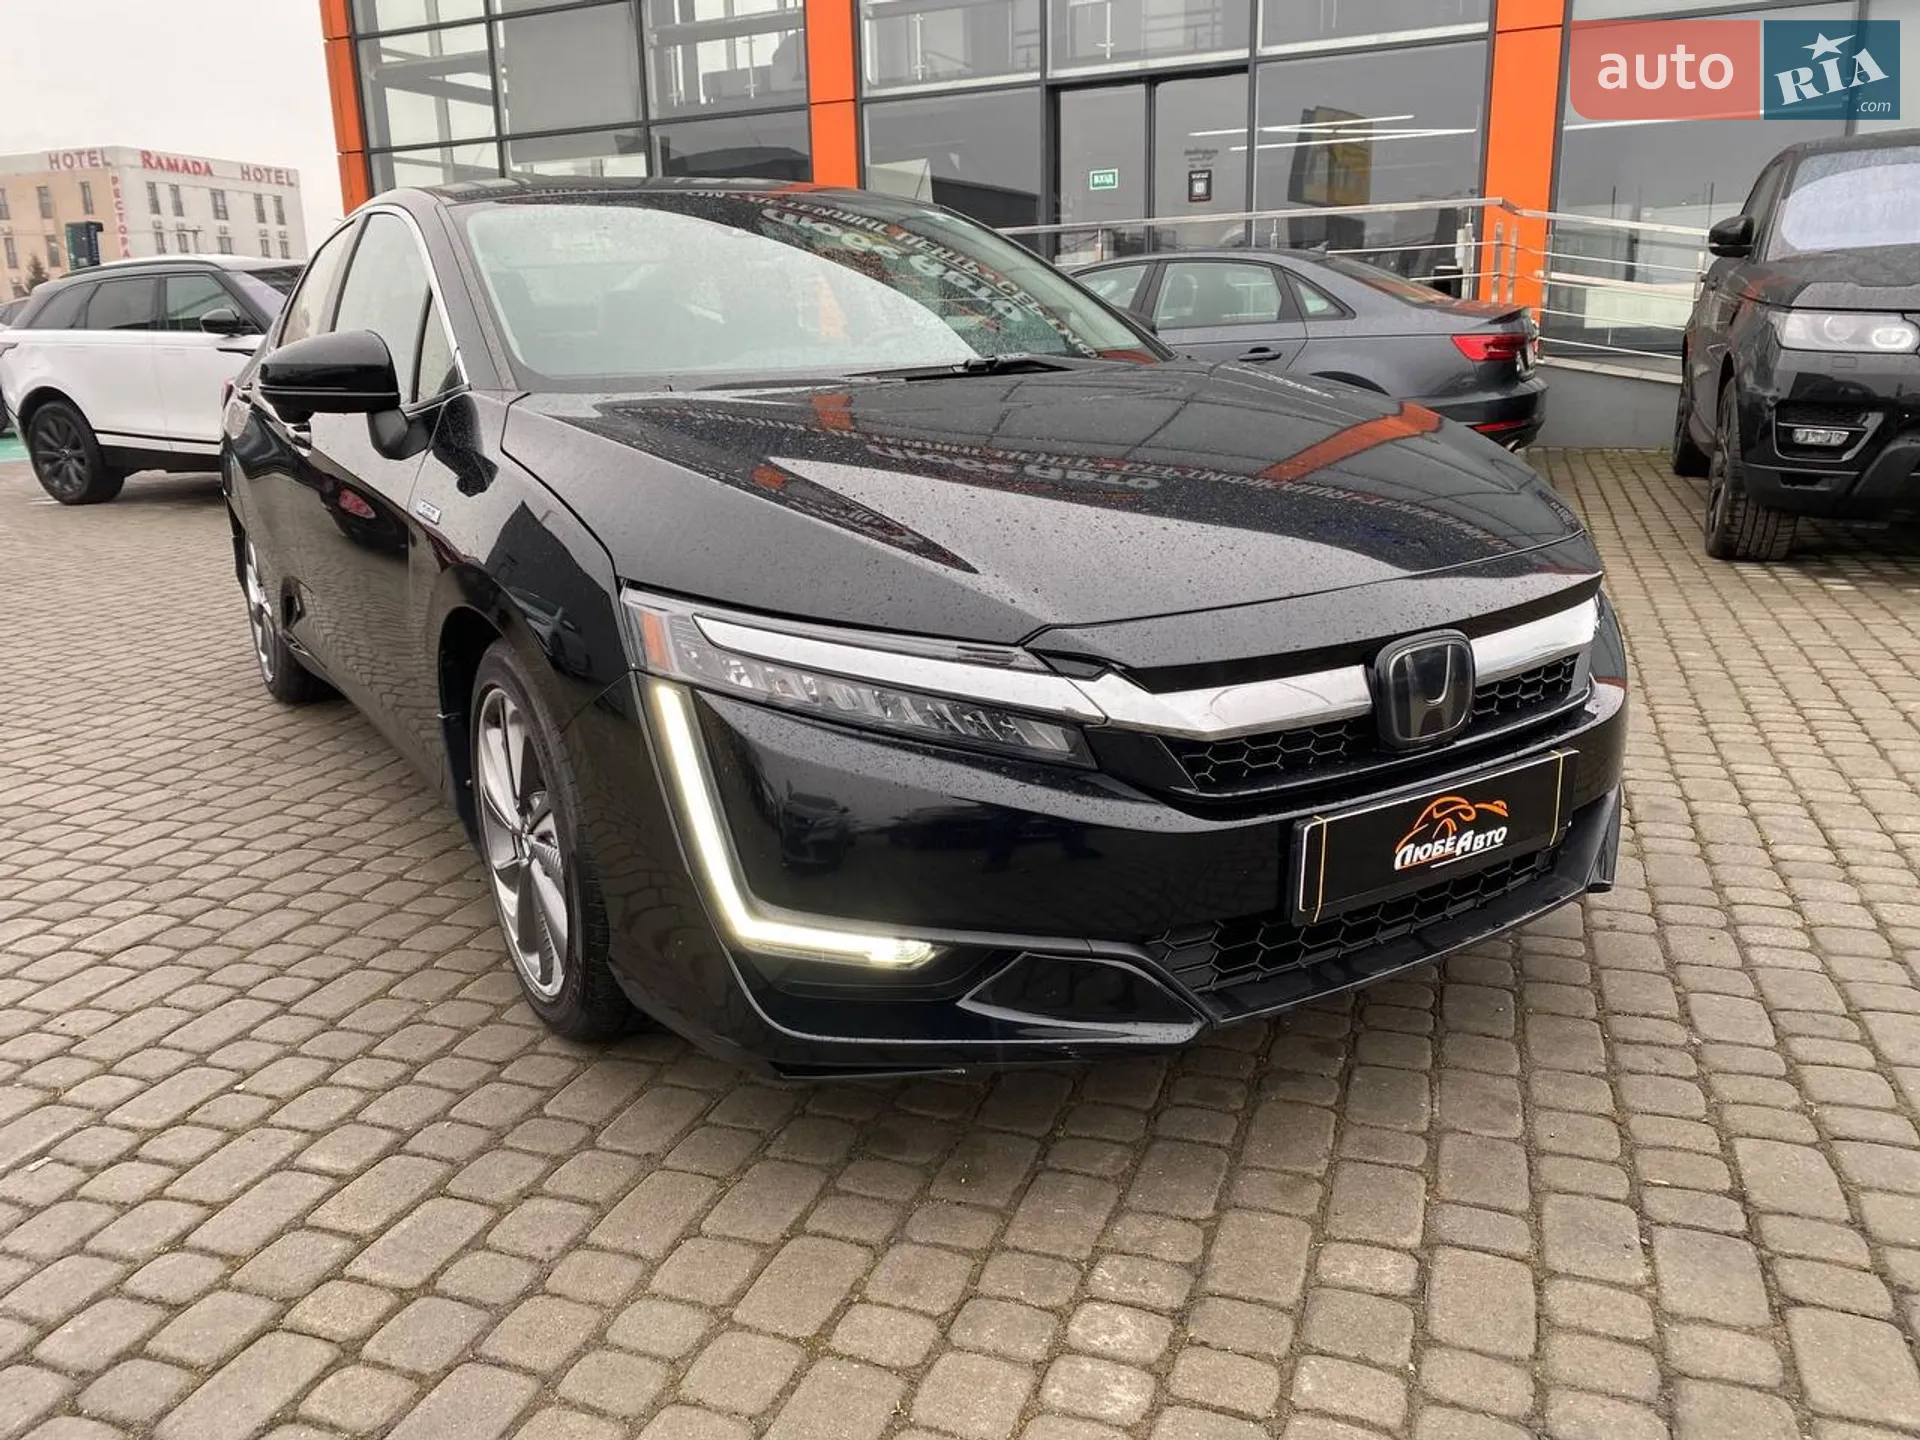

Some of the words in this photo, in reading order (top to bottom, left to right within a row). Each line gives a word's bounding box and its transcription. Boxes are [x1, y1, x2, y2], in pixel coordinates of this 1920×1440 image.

[48, 149, 112, 170] HOTEL
[140, 150, 214, 177] RAMADA
[241, 165, 295, 187] HOTEL
